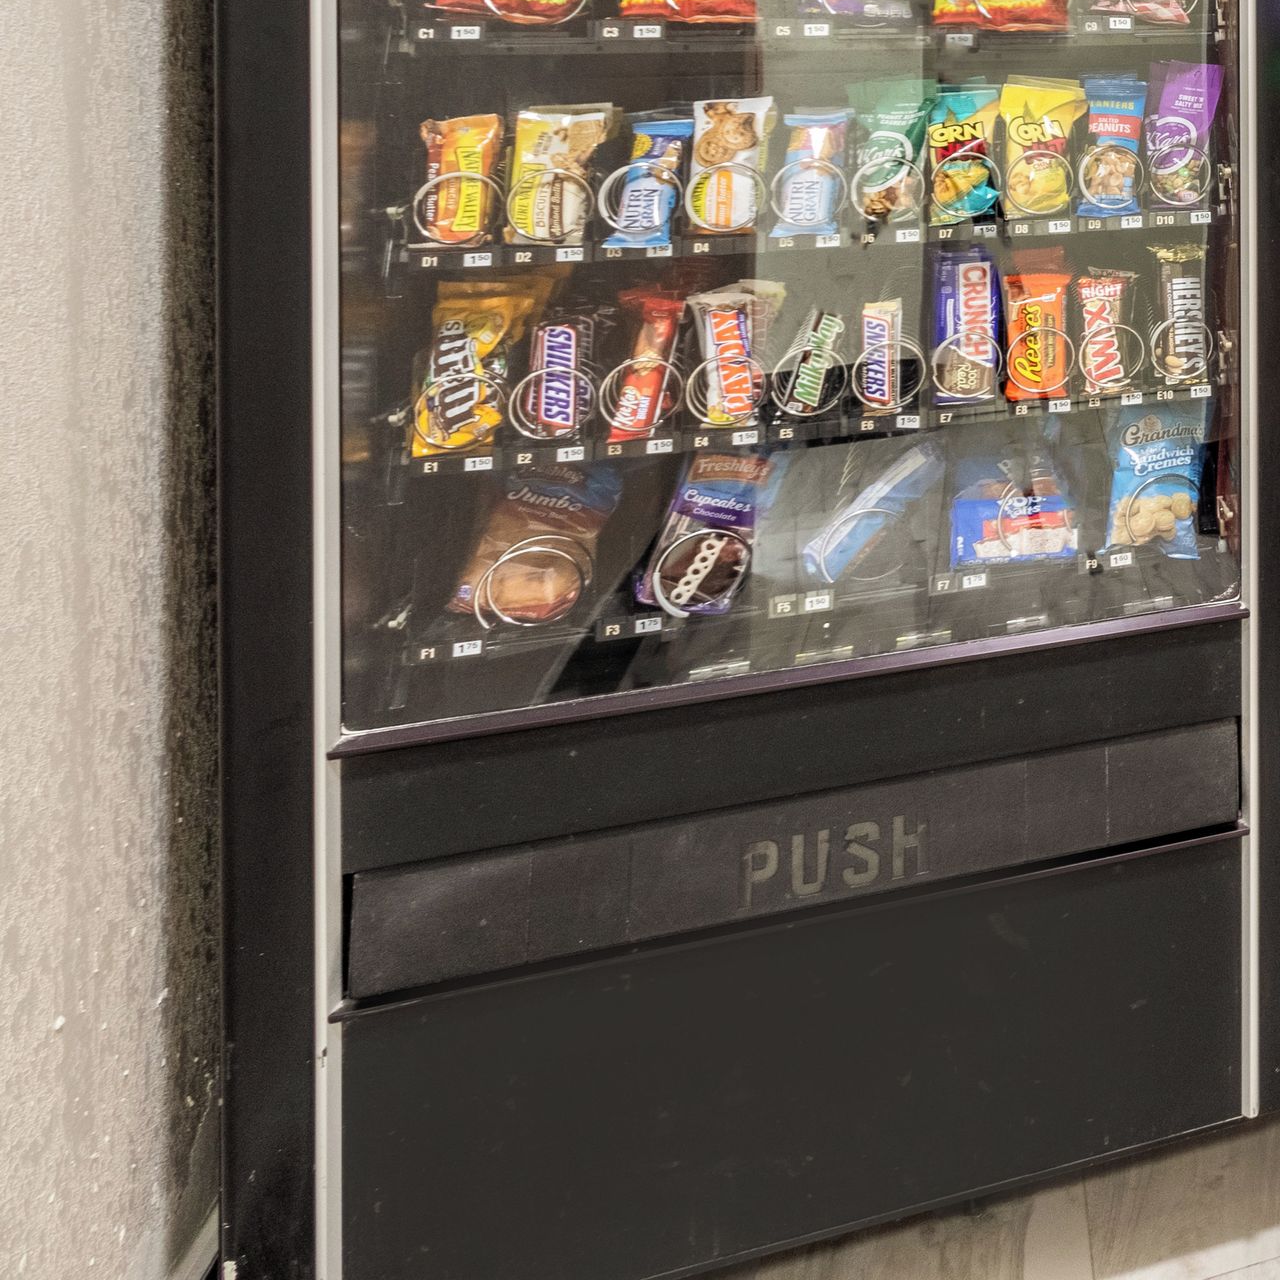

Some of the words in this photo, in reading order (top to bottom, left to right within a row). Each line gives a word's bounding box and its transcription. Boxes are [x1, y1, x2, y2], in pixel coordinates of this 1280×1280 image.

[928, 121, 984, 147] CORN
[1008, 115, 1065, 147] CORN
[461, 150, 481, 189] NATRE
[790, 181, 804, 221] NUTRI
[804, 180, 820, 221] GRAIN
[426, 195, 438, 222] Butter
[456, 191, 479, 230] VALLEY
[624, 189, 642, 229] NUTRI
[641, 188, 659, 228] GRAIN
[1088, 220, 1101, 229] D9
[1156, 216, 1174, 225] D10
[939, 229, 953, 238] D7
[1015, 225, 1029, 234] D8
[779, 238, 794, 247] D5
[861, 234, 875, 243] D6
[607, 248, 622, 257] D3
[694, 243, 710, 253] D4
[422, 257, 438, 267] D1
[515, 252, 532, 262] D2
[1081, 284, 1123, 299] RIGHT
[960, 265, 993, 360] CRUNCH
[1172, 277, 1206, 371] HERSHEY'S
[1084, 300, 1125, 394] TWIX
[710, 310, 753, 416] PAYDAY
[866, 321, 886, 398] SNICKERS
[543, 327, 573, 424] SNICKERS
[956, 363, 971, 391] Real
[1157, 391, 1174, 400] E10
[1089, 398, 1100, 407] E9
[1016, 405, 1028, 415] E8
[940, 413, 953, 423] E7
[861, 421, 874, 431] E6
[779, 429, 794, 438] E5
[1121, 422, 1205, 447] Grandma's
[694, 437, 709, 447] E4
[608, 446, 622, 456] E3
[1131, 446, 1194, 466] Sandwich
[517, 454, 532, 464] E2
[424, 462, 438, 473] E1
[698, 458, 769, 477] Freshley's
[1135, 456, 1191, 476] Cremes
[507, 486, 584, 512] Jumbo
[684, 488, 752, 513] Cupcakes
[693, 508, 737, 522] Chocolate
[1086, 559, 1098, 569] F9
[938, 580, 950, 590] F7
[777, 602, 790, 613] F5
[606, 625, 620, 635] F3
[421, 648, 435, 660] F1
[738, 815, 928, 910] PUSH
